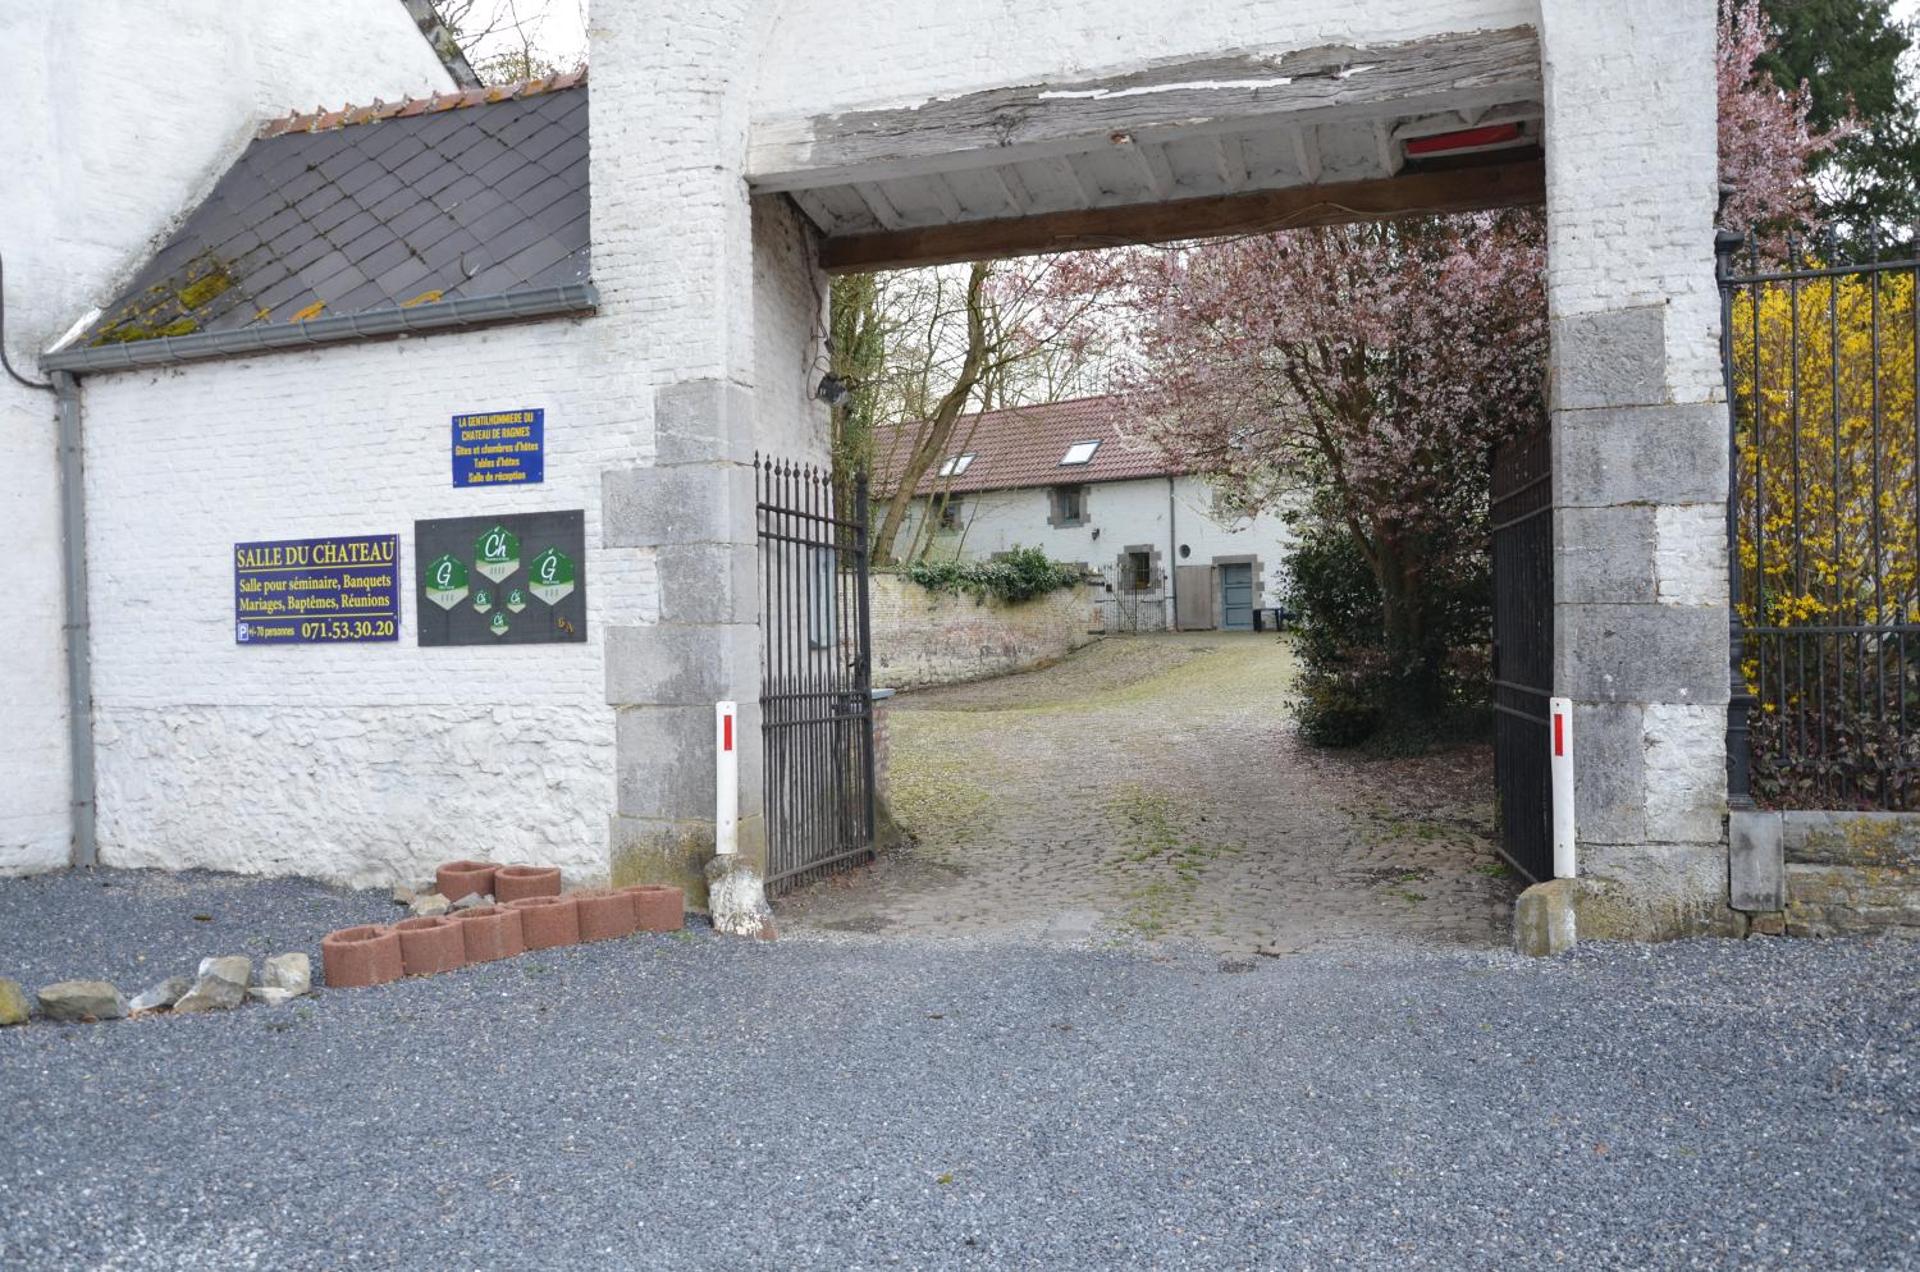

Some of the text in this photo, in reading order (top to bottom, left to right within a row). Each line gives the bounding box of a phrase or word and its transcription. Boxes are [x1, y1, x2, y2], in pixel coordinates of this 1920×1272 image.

[237, 541, 395, 568] SALLE DU CHATEAU
[485, 533, 506, 557] Ch
[239, 574, 391, 595] Salle pour séminaire, Banquets
[239, 593, 390, 614] Mariages, Baptêmes, Réunions
[301, 620, 394, 640] 071.53.30.20
